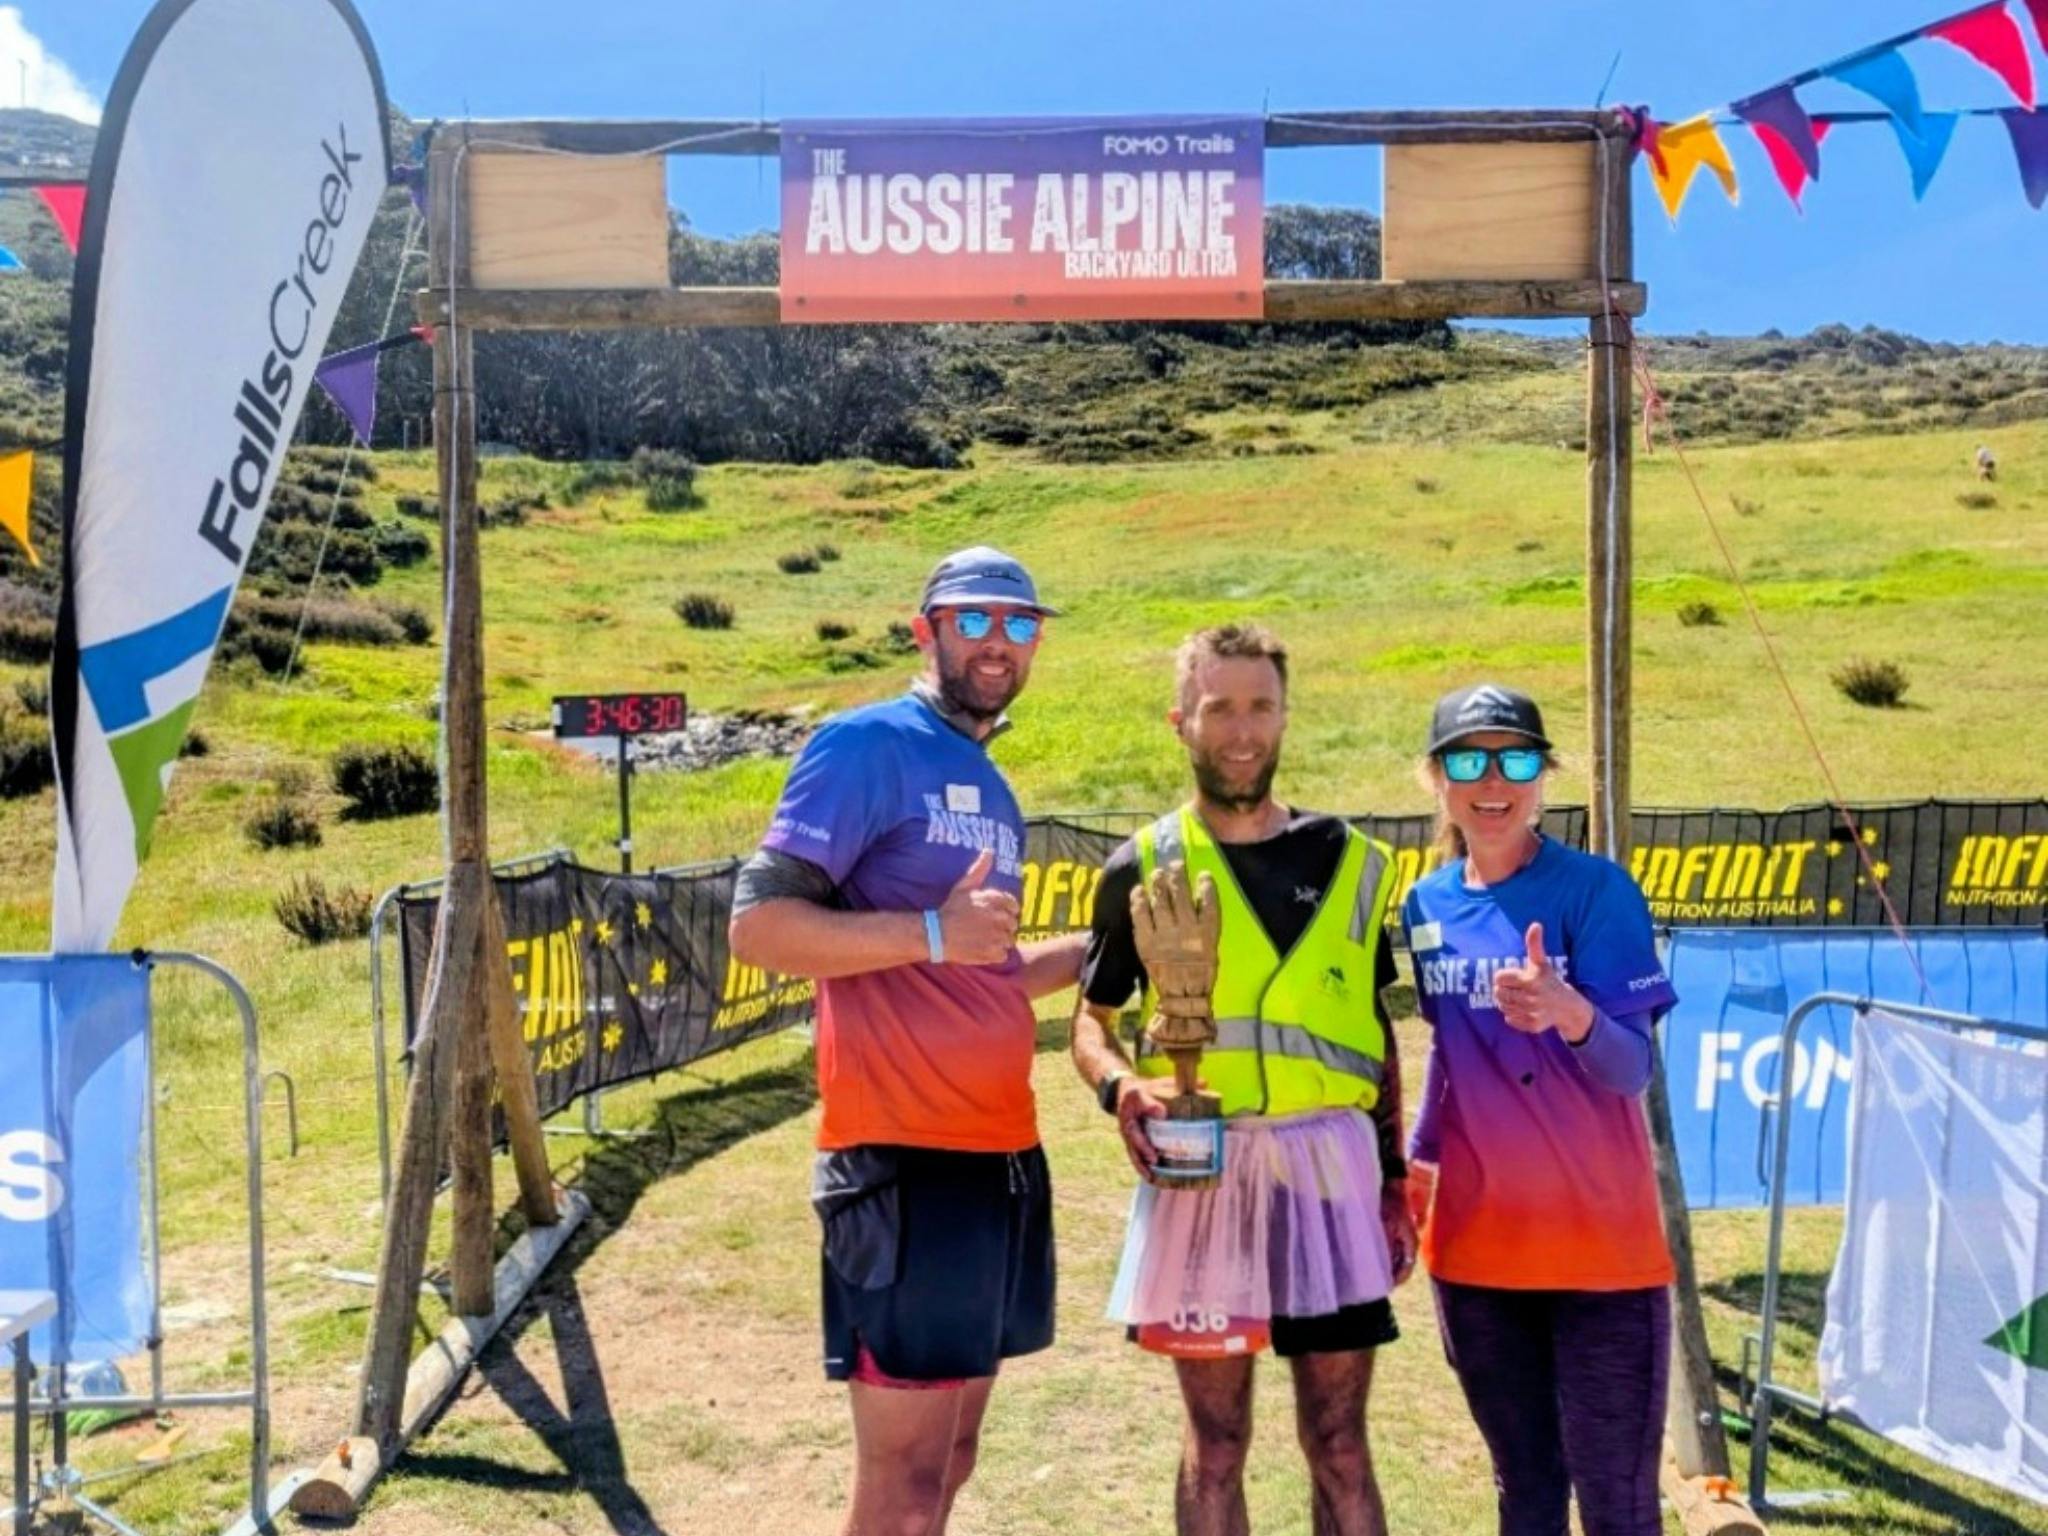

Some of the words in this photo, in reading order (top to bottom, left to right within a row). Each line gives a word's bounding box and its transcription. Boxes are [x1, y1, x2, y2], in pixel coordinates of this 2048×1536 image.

[1103, 135, 1168, 155] FOMO
[1175, 134, 1235, 154] Trails
[812, 148, 846, 175] THE
[805, 173, 1014, 254] AUSSIE
[1029, 170, 1236, 253] ALPINE
[1064, 250, 1170, 279] BACKYARD
[1176, 249, 1237, 278] ULTRA
[1648, 901, 1713, 919] TRITION
[1717, 898, 1816, 918] AUSTRALIA
[1422, 957, 1469, 995] SSIE
